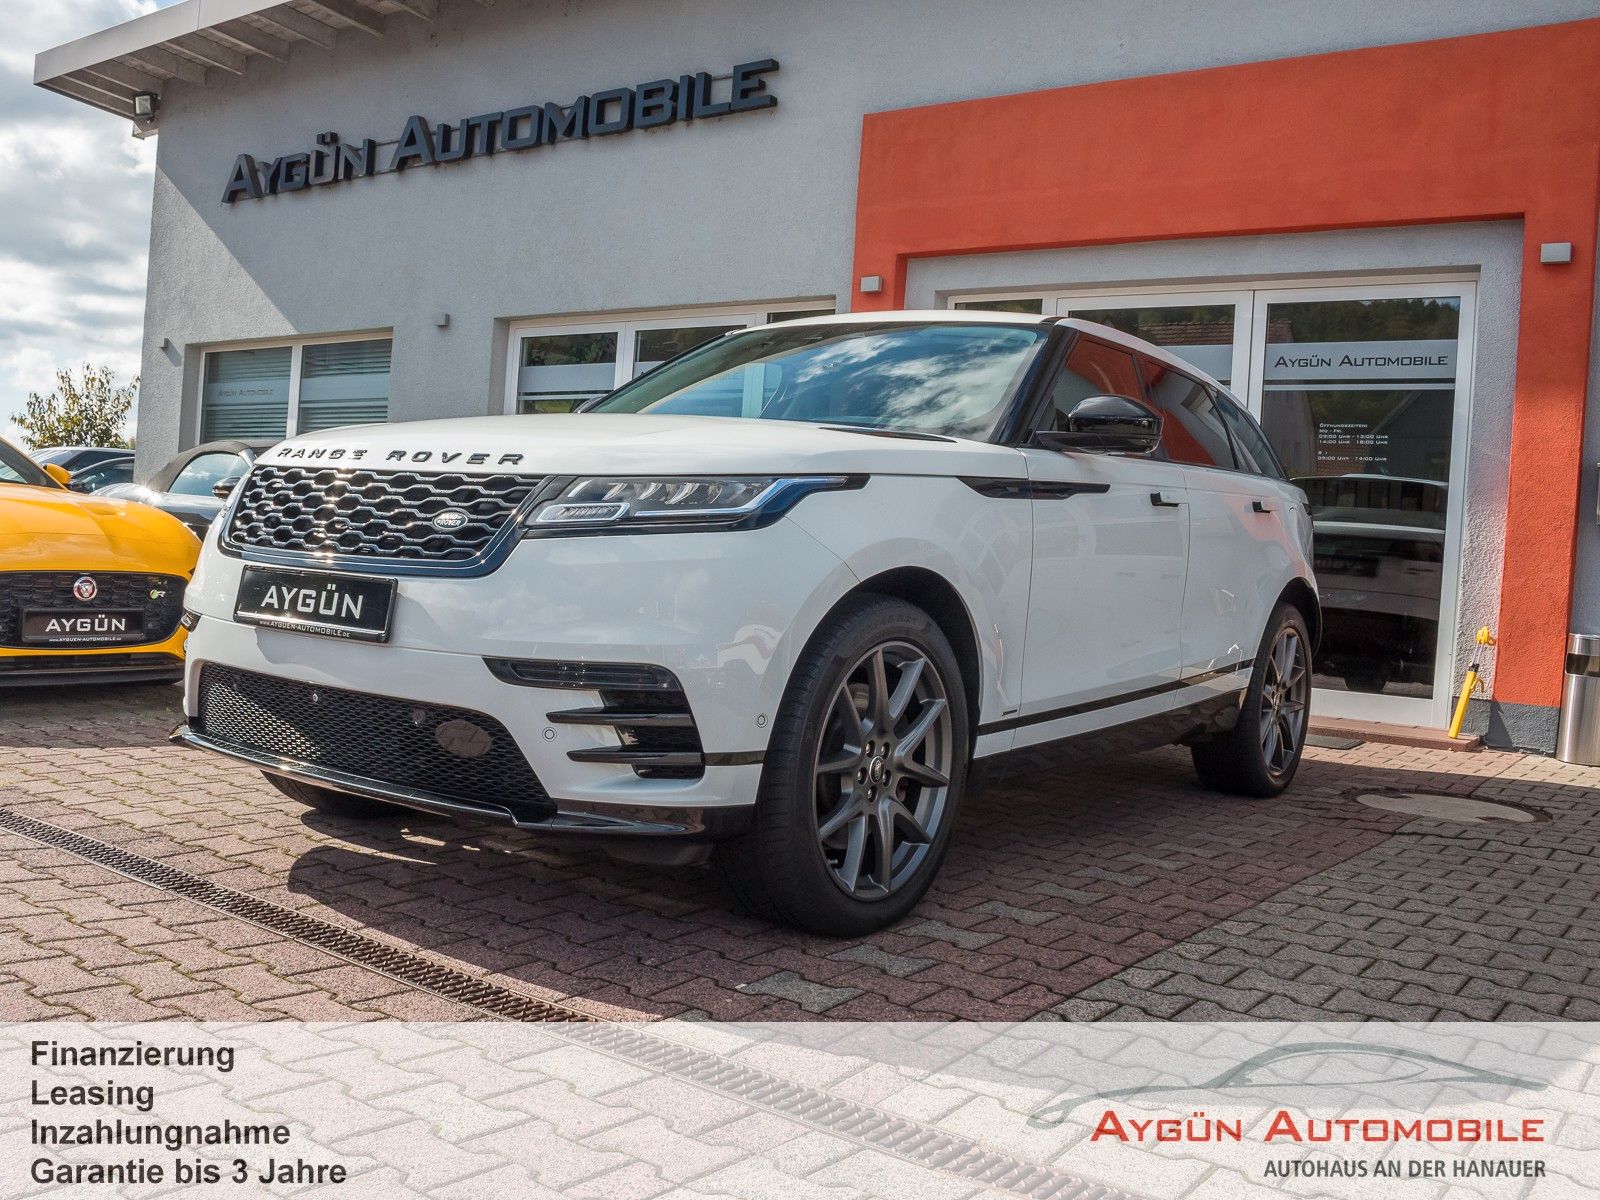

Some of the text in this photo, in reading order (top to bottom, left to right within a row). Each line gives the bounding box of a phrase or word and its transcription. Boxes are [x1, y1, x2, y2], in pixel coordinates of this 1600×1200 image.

[221, 58, 779, 204] AYGÜN AUTOMOBILE
[1274, 354, 1449, 368] AYGÜN AUTOMOBILE
[277, 447, 524, 466] RANGE ROVER
[260, 583, 364, 620] AYGÜN
[45, 614, 126, 632] AYGÜN
